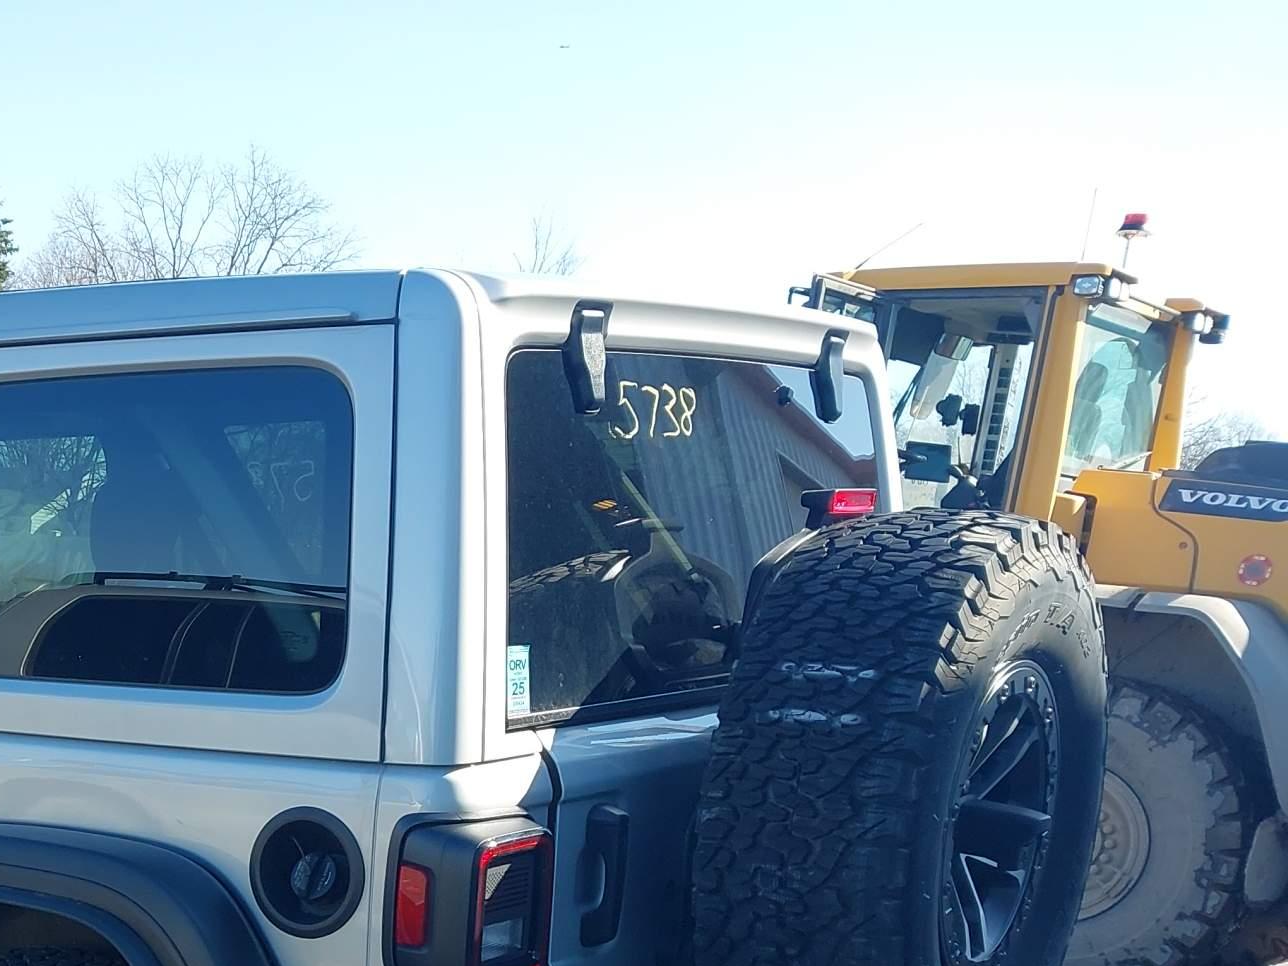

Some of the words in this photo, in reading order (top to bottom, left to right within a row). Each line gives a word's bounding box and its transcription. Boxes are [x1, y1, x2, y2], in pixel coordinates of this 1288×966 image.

[608, 380, 696, 439] 5738
[509, 659, 527, 671] ORV
[512, 681, 525, 696] 25
